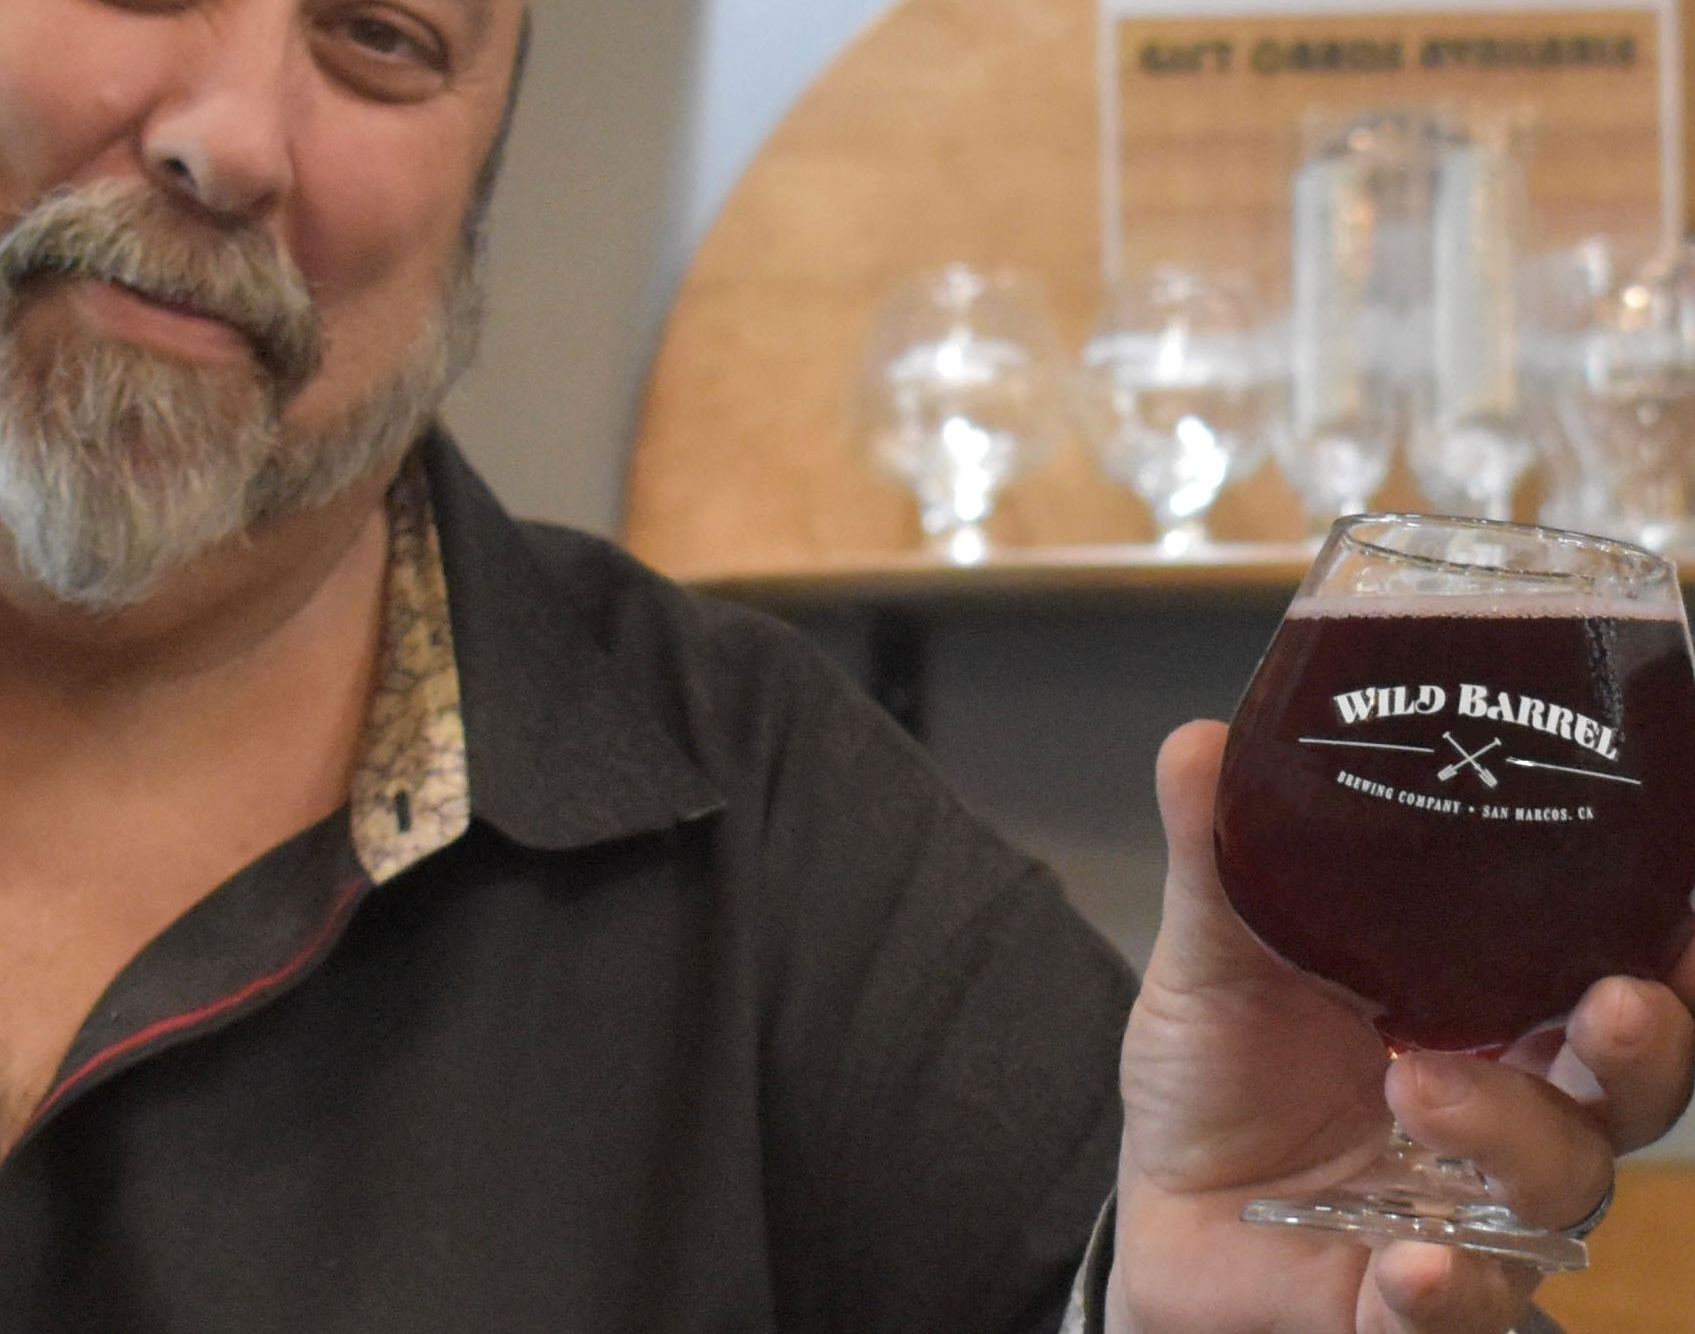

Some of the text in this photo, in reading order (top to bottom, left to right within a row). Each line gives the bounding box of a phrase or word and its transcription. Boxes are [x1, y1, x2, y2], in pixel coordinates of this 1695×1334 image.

[1333, 683, 1618, 761] WILD BARREL
[1336, 770, 1394, 800] BREWING
[1397, 790, 1462, 815] COMPANY
[1482, 805, 1510, 820] SAN
[1577, 806, 1595, 820] CA
